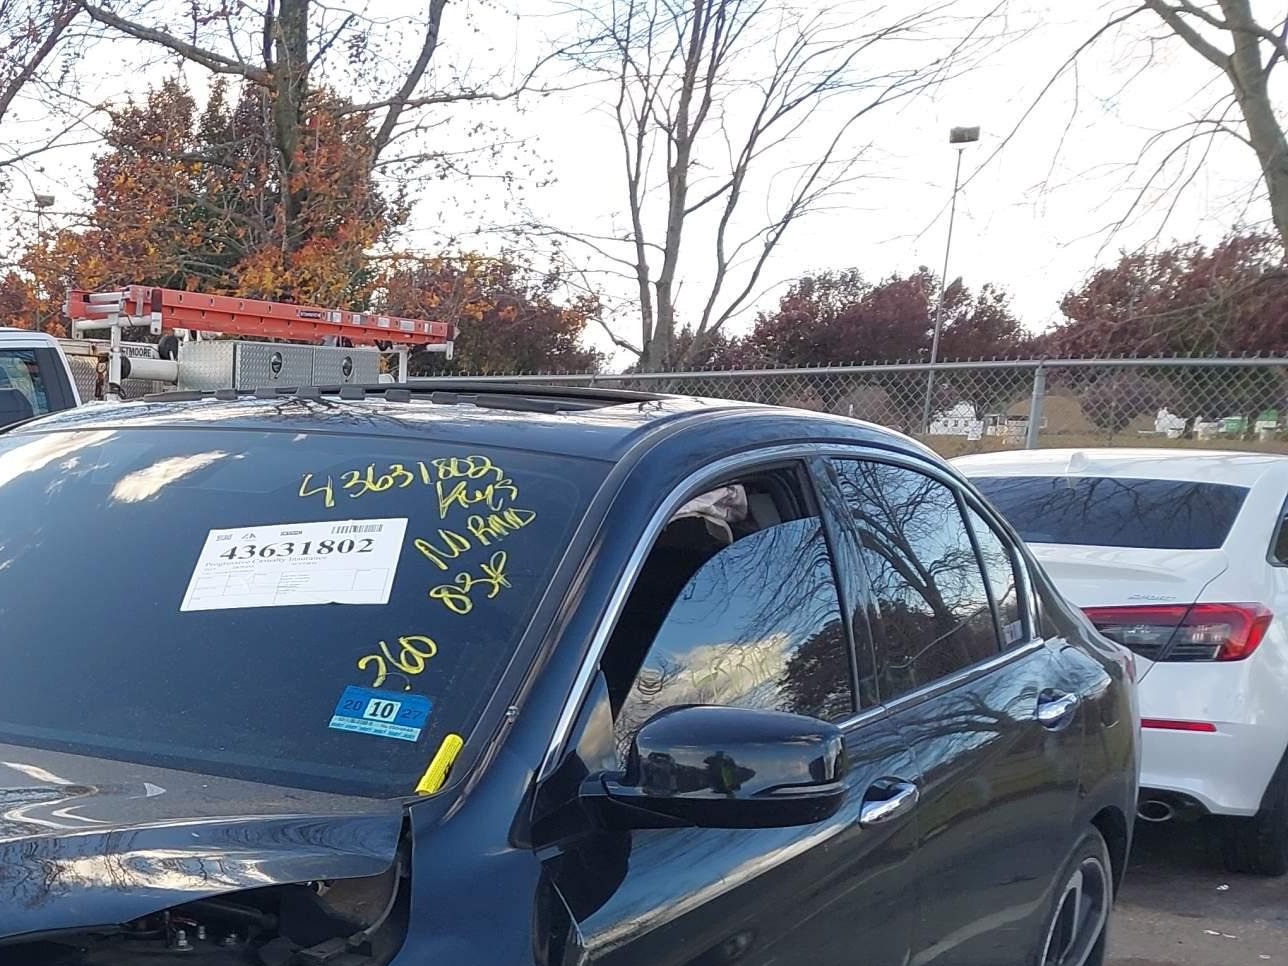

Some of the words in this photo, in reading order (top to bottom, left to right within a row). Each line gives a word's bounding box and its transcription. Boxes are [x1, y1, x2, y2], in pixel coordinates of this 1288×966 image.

[220, 538, 375, 560] 43631802
[369, 701, 395, 719] 10
[401, 708, 424, 720] 27
